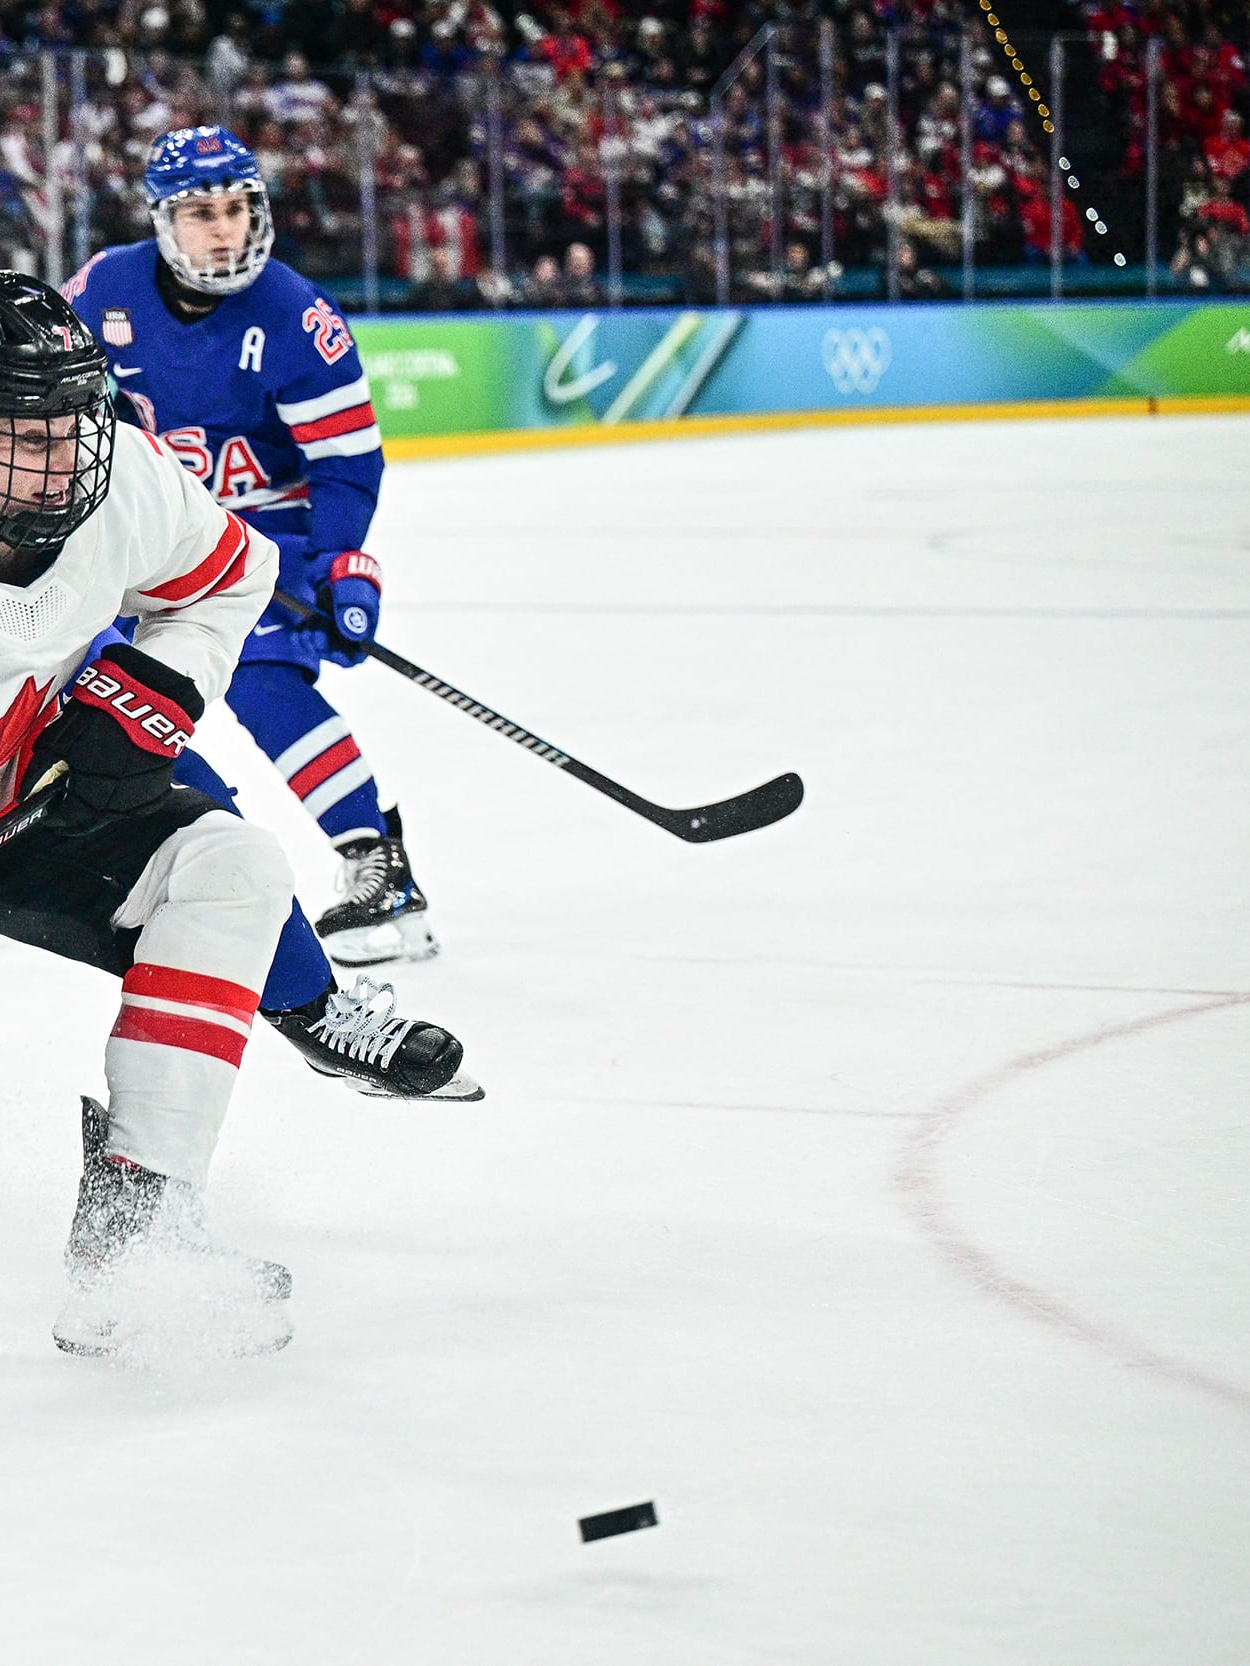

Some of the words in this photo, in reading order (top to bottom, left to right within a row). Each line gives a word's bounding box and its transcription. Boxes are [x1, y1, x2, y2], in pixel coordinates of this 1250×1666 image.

[51, 325, 73, 351] 7
[239, 326, 266, 373] A
[75, 666, 191, 755] BAUER
